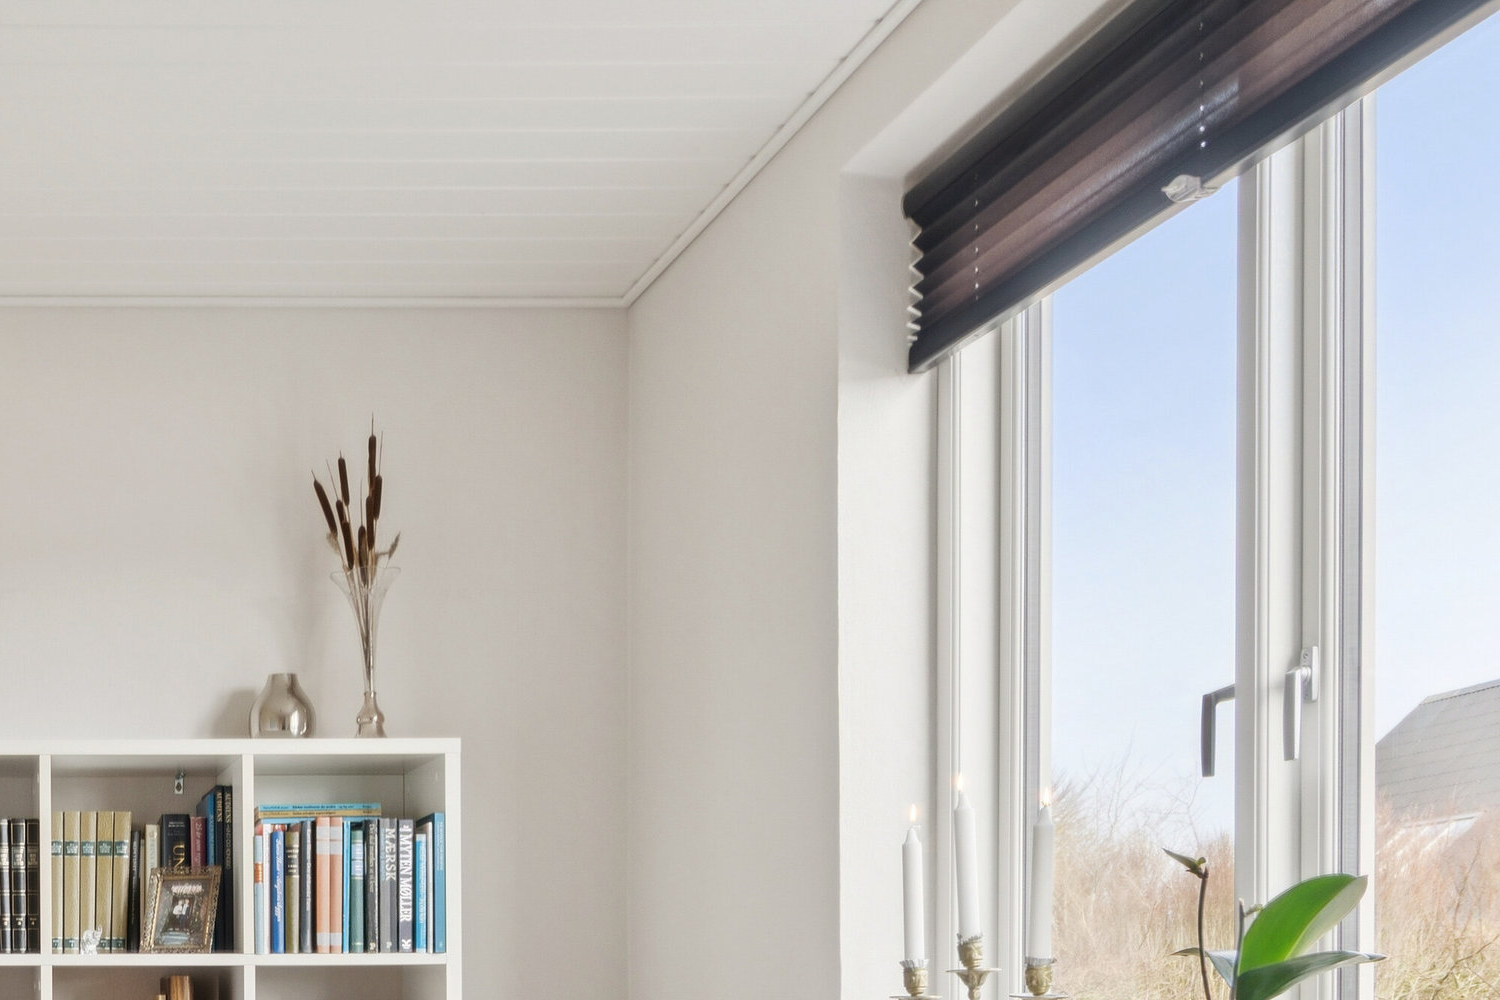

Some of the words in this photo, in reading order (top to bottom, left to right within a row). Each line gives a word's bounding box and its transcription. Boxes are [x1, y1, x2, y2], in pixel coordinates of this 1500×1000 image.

[385, 828, 397, 882] MÆRSK
[399, 834, 413, 876] MYTEN
[399, 877, 413, 923] MØLLER
